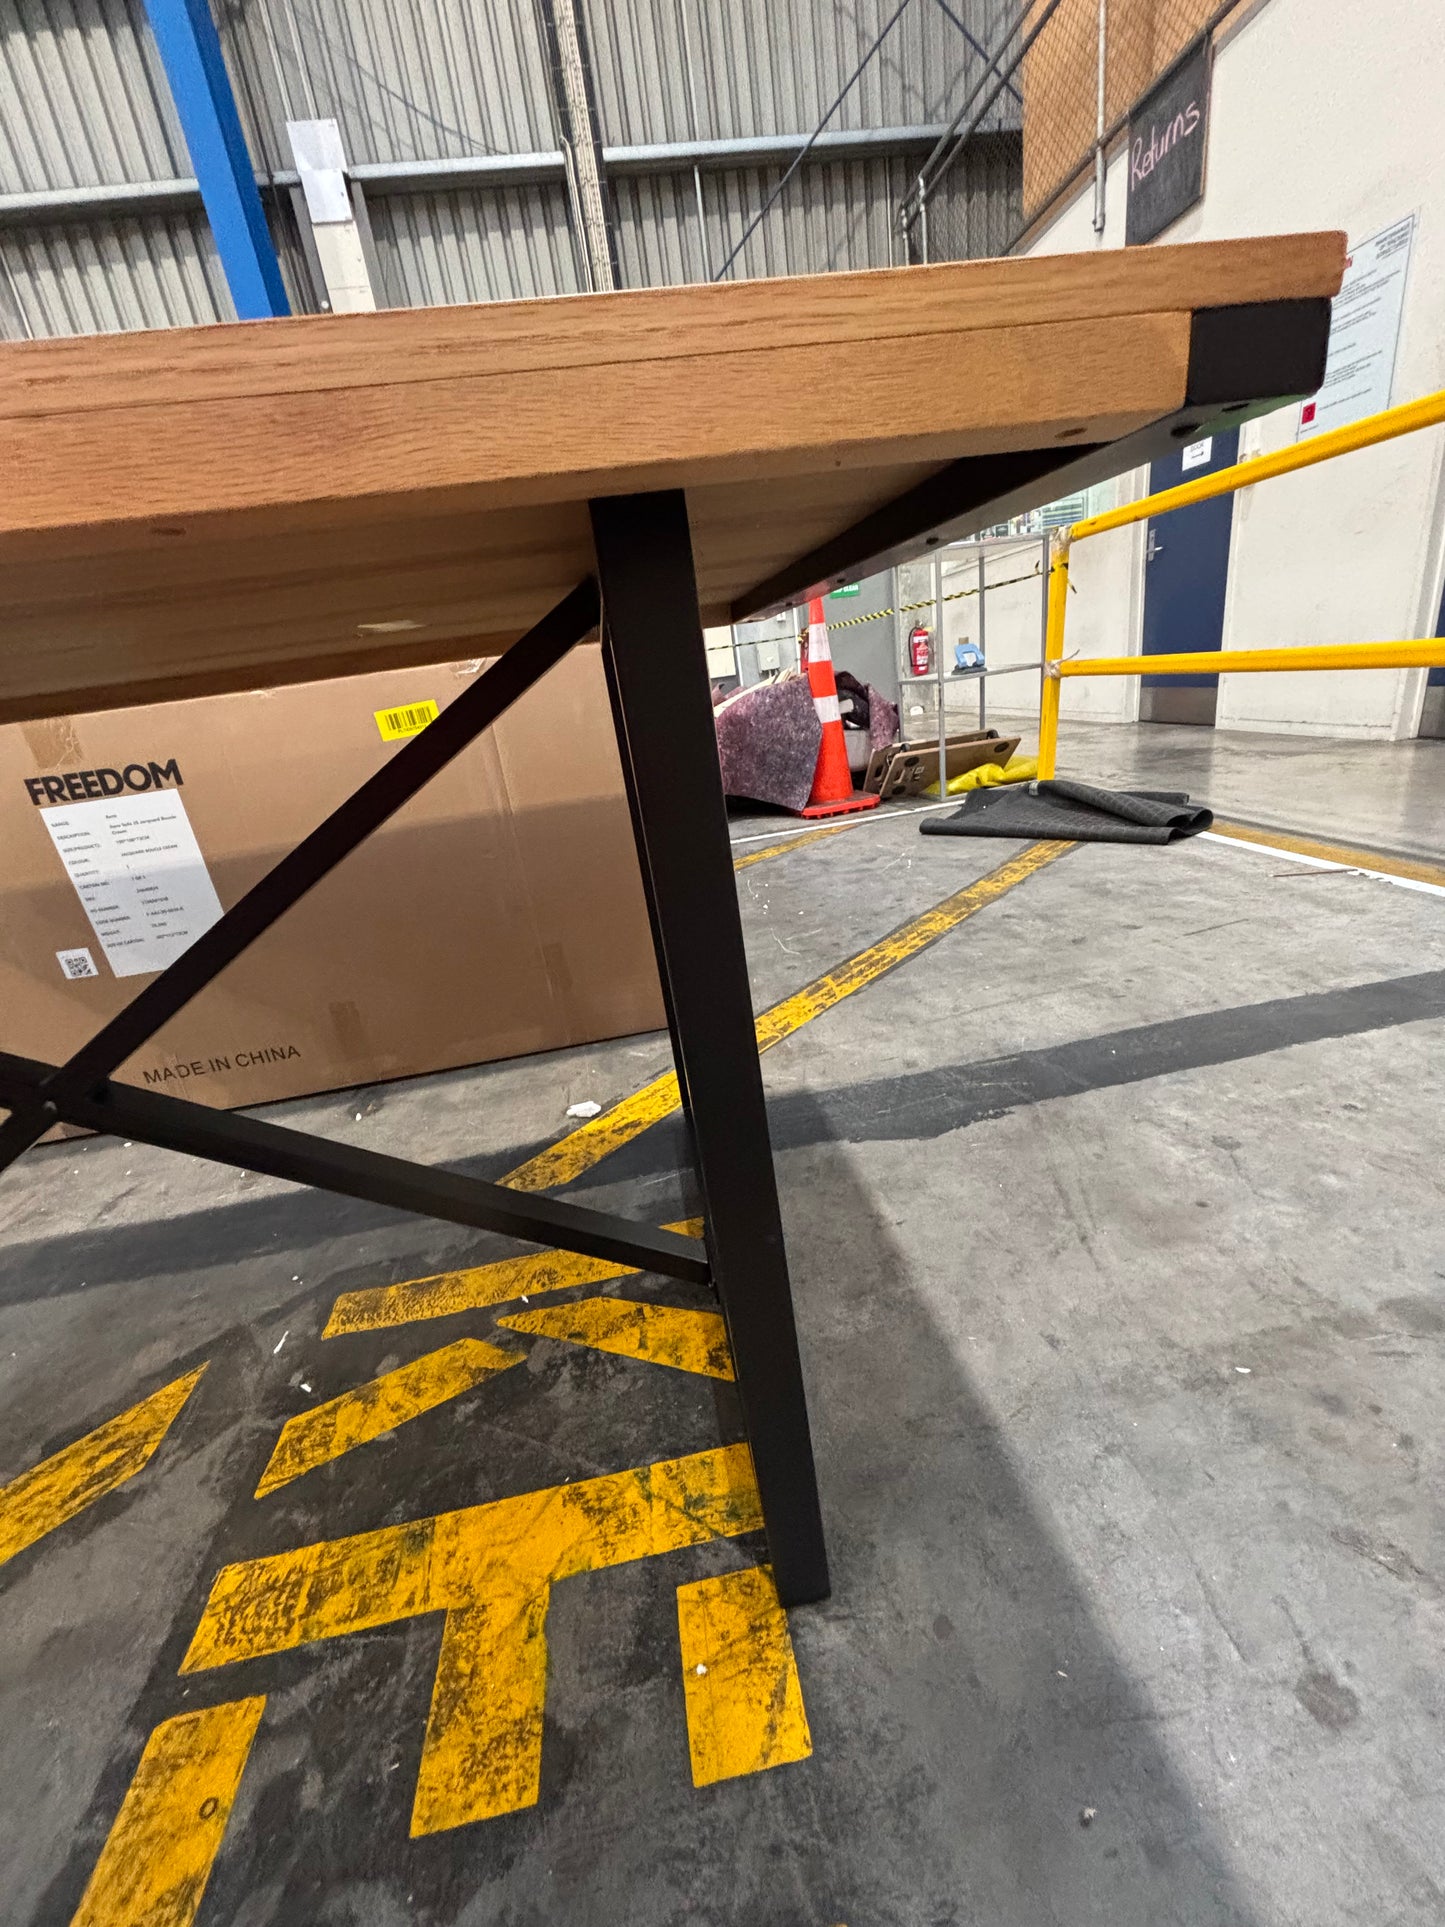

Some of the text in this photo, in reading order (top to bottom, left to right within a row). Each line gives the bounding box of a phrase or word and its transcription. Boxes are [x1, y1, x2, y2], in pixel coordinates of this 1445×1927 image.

[1131, 100, 1201, 192] Returns
[24, 759, 184, 806] FREEDOM
[142, 1045, 302, 1084] MADE IN CHINA
